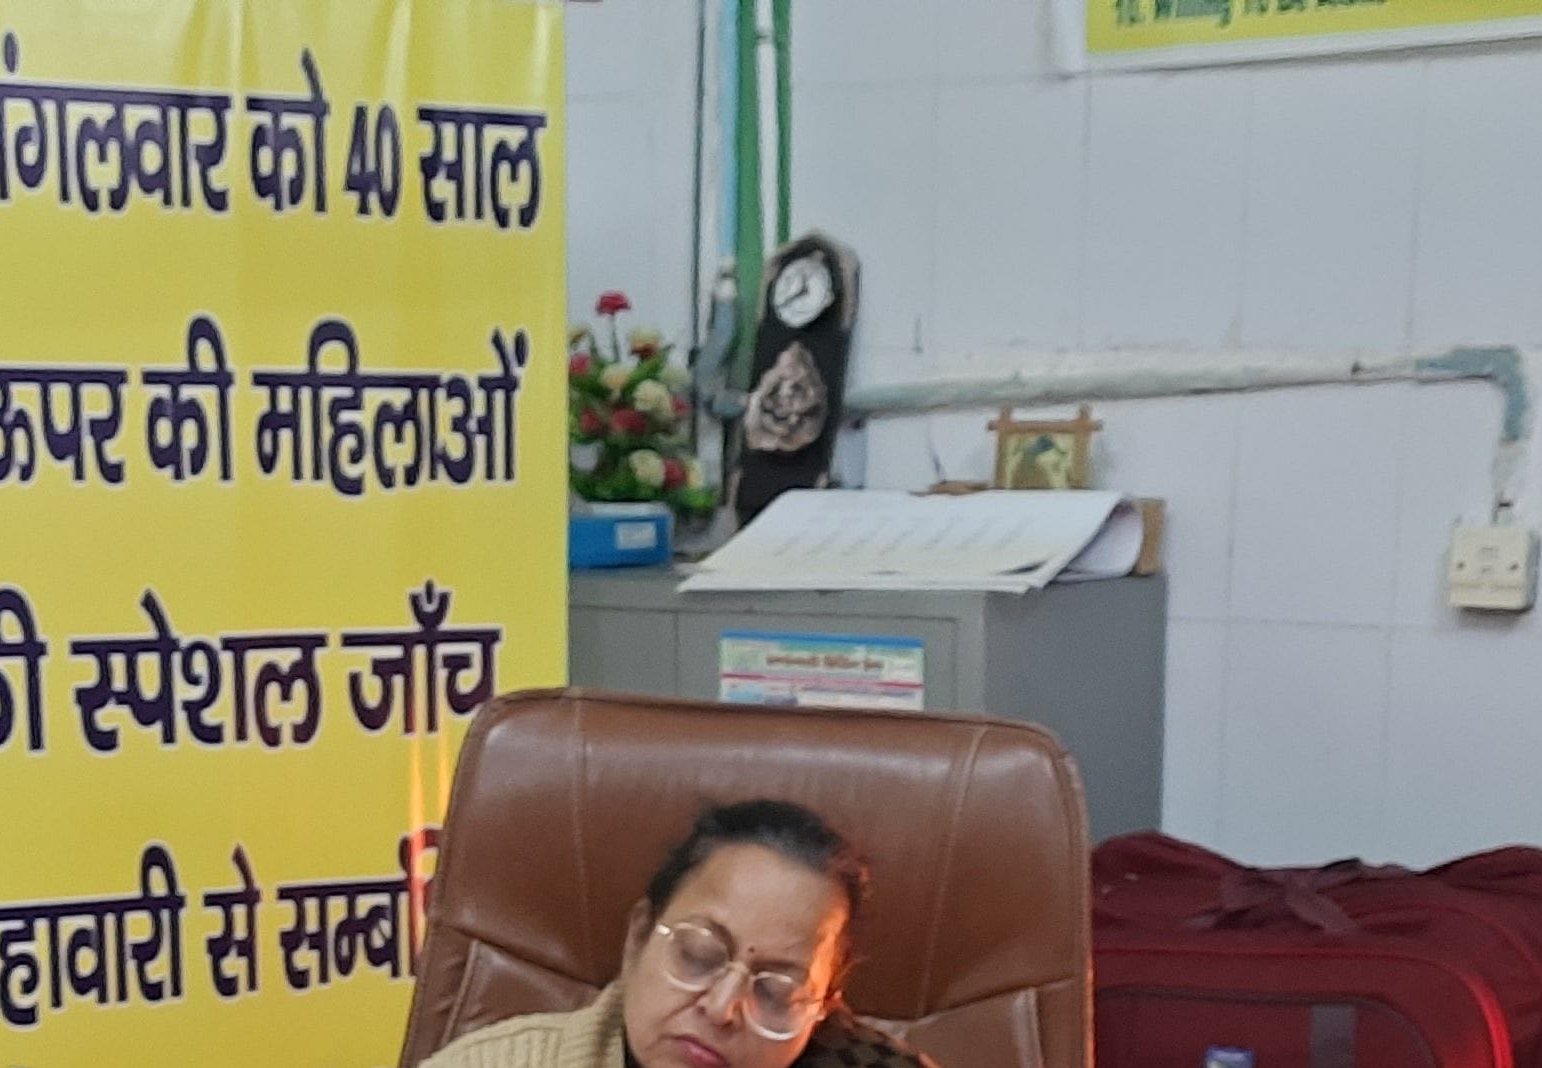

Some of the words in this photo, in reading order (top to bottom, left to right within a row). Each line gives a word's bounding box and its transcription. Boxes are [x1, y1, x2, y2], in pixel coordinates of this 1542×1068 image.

[246, 51, 329, 212] को
[345, 106, 401, 217] 40
[417, 107, 546, 229] साल
[142, 317, 234, 481] की
[252, 320, 528, 495] महिलाओं
[70, 592, 327, 751] स्पेशल
[341, 580, 502, 735] जाँच
[203, 848, 260, 997] से
